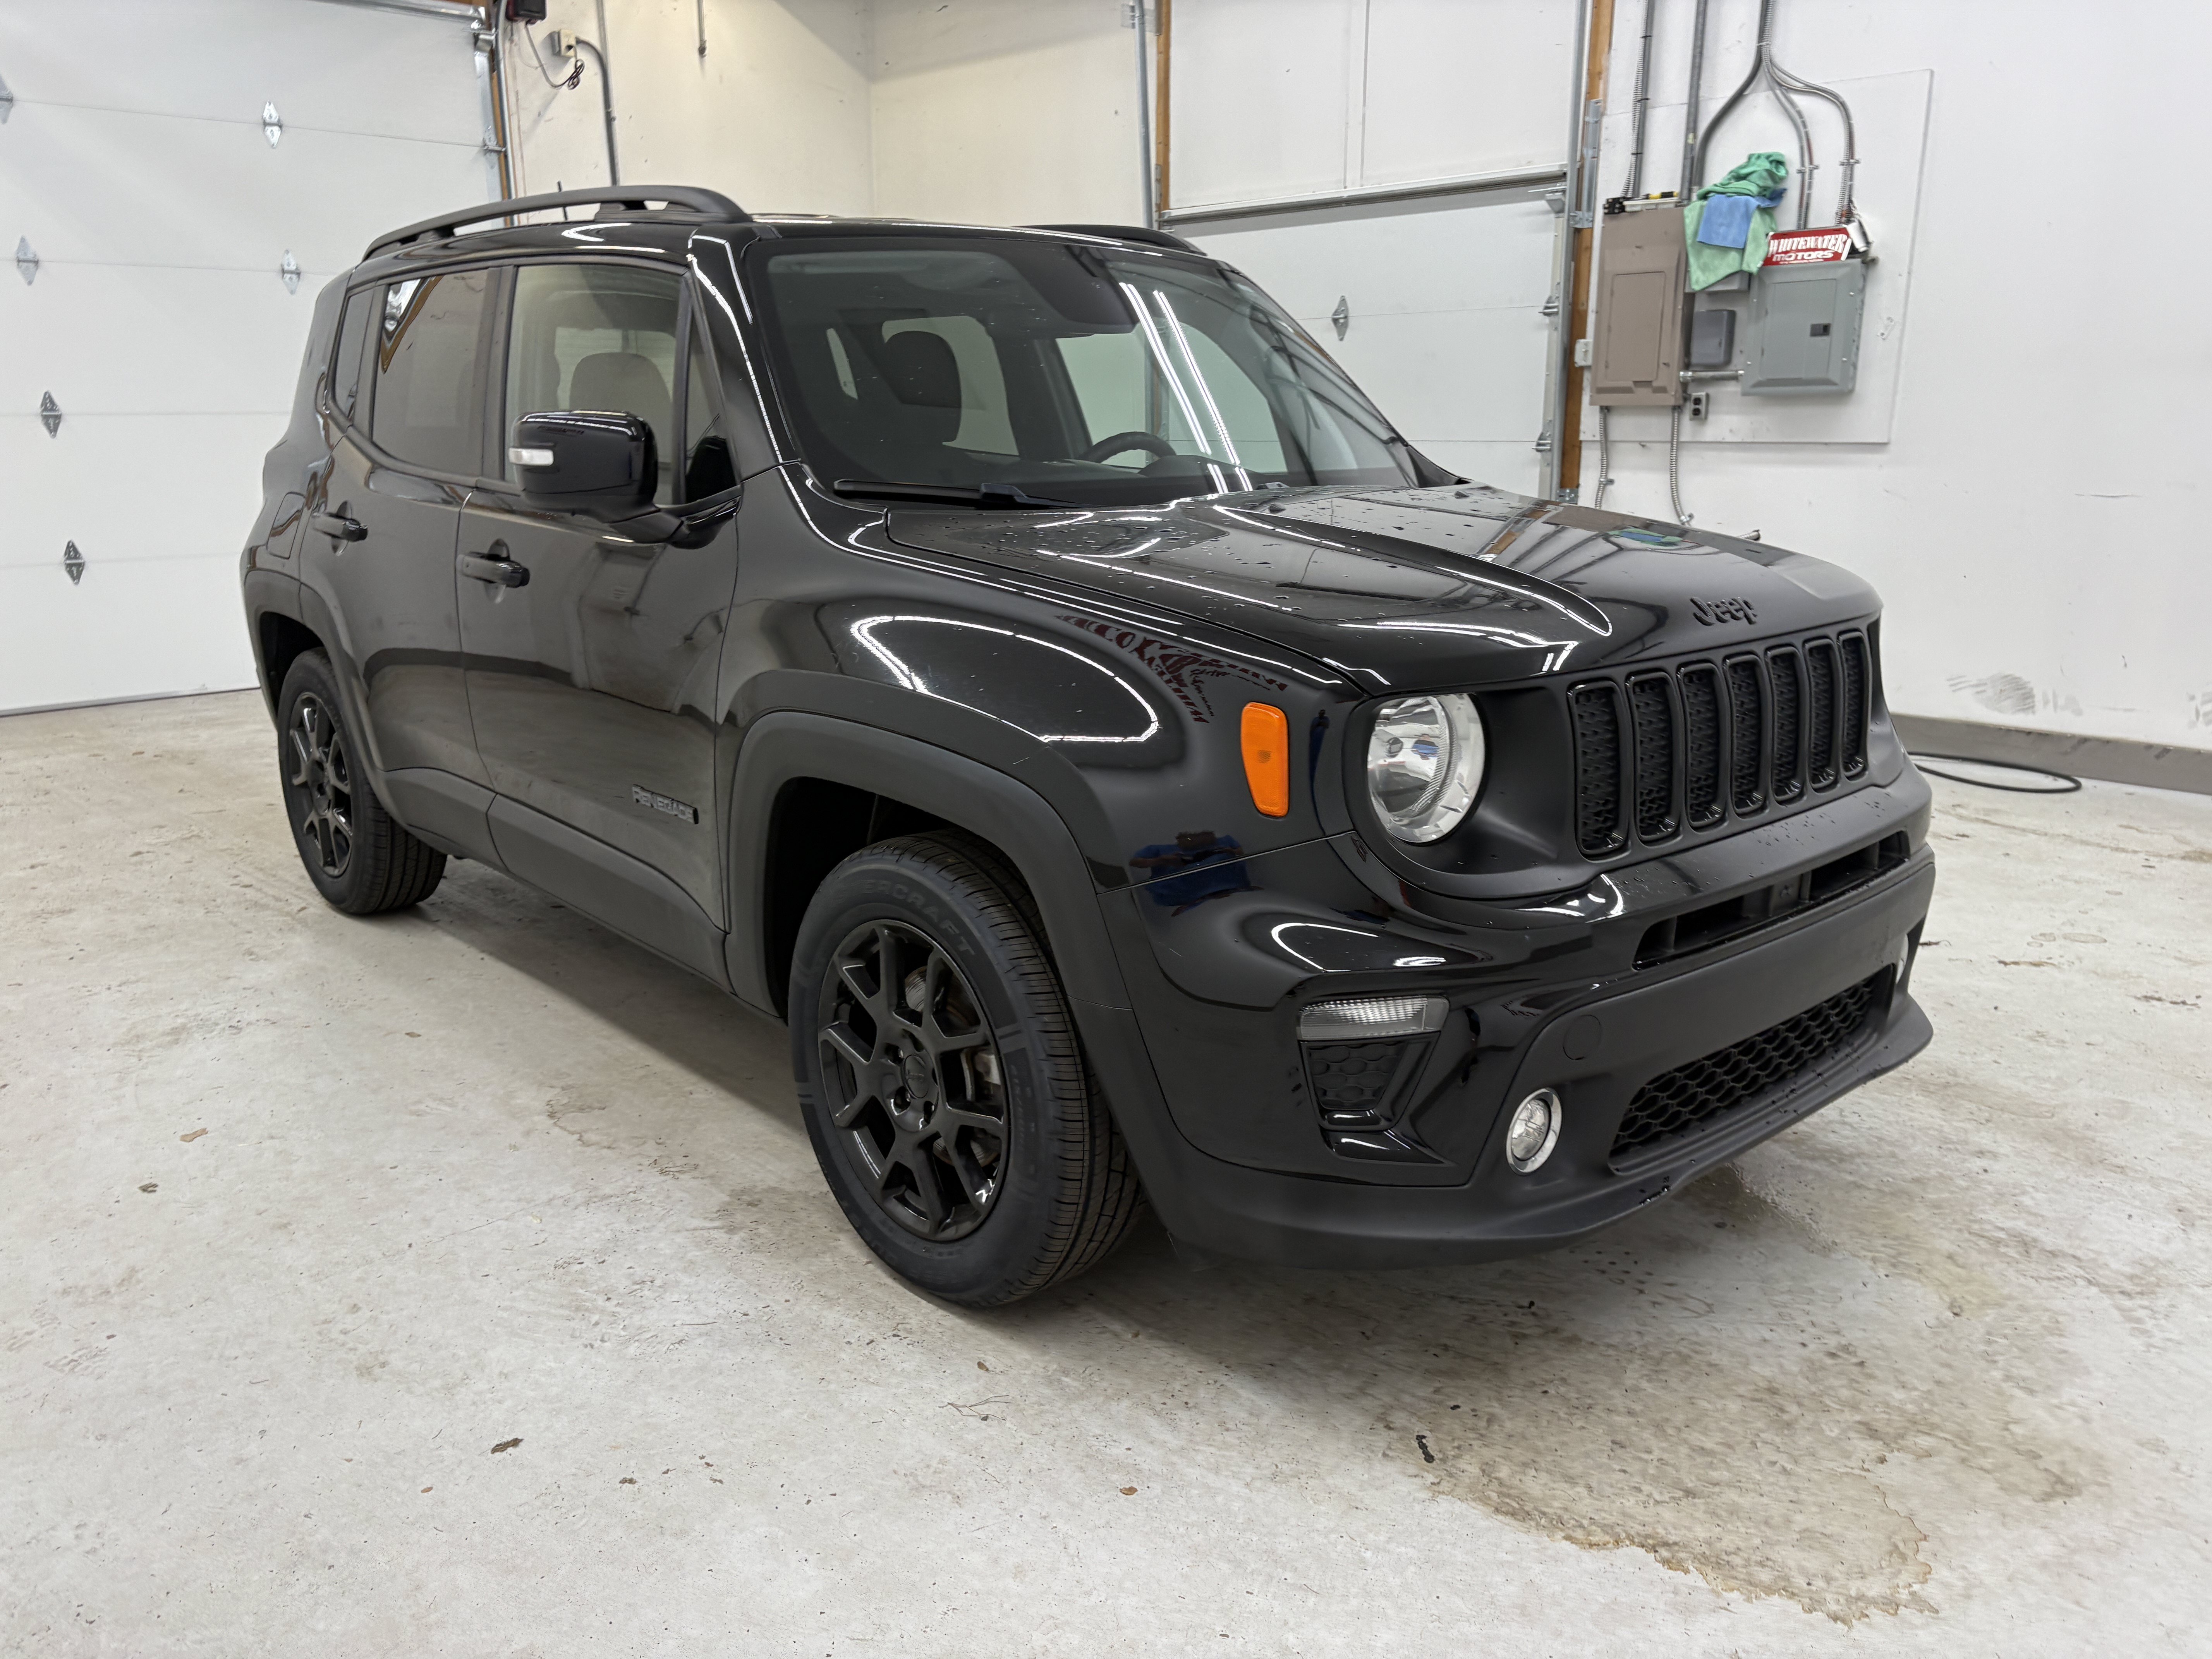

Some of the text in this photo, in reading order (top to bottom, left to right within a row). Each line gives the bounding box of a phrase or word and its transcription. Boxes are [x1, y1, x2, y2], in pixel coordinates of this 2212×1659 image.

[1767, 234, 1848, 257] WHITEWATER
[1772, 251, 1834, 261] MOTORS
[1690, 596, 1758, 626] Jeep
[632, 785, 697, 824] RENEGADE
